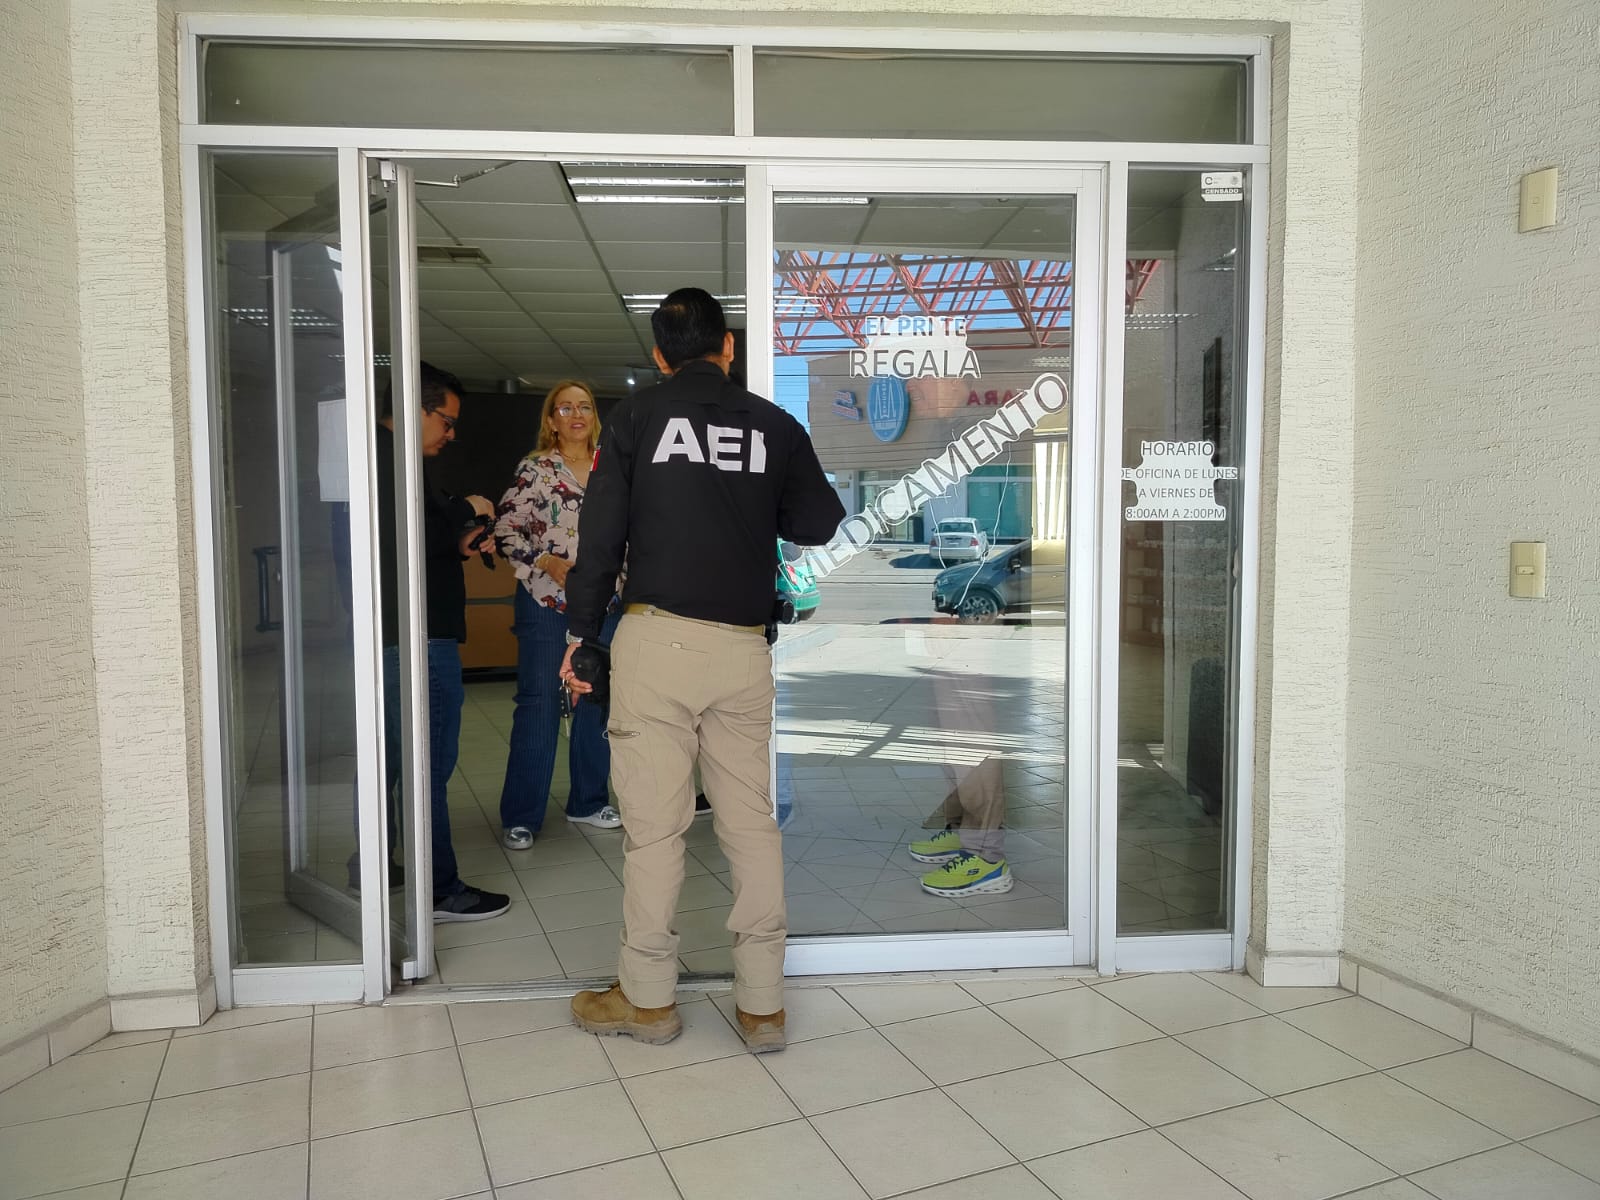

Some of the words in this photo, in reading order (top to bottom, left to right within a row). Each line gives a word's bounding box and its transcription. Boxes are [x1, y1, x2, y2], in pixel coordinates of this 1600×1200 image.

[866, 317, 890, 336] EL
[898, 317, 932, 337] PRI
[940, 317, 966, 336] TE
[850, 349, 980, 377] REGALA
[652, 417, 767, 474] AEI
[1142, 442, 1214, 456] HORARIO
[1136, 469, 1181, 479] OFICINA
[1185, 468, 1199, 479] DE
[1202, 468, 1237, 479] LUNES
[1139, 488, 1146, 498] A
[1150, 488, 1196, 498] VIERNES
[1200, 488, 1214, 498] DE
[1126, 508, 1169, 519] 8:00AM
[1172, 508, 1180, 519] A
[1183, 508, 1225, 519] 2:00PM
